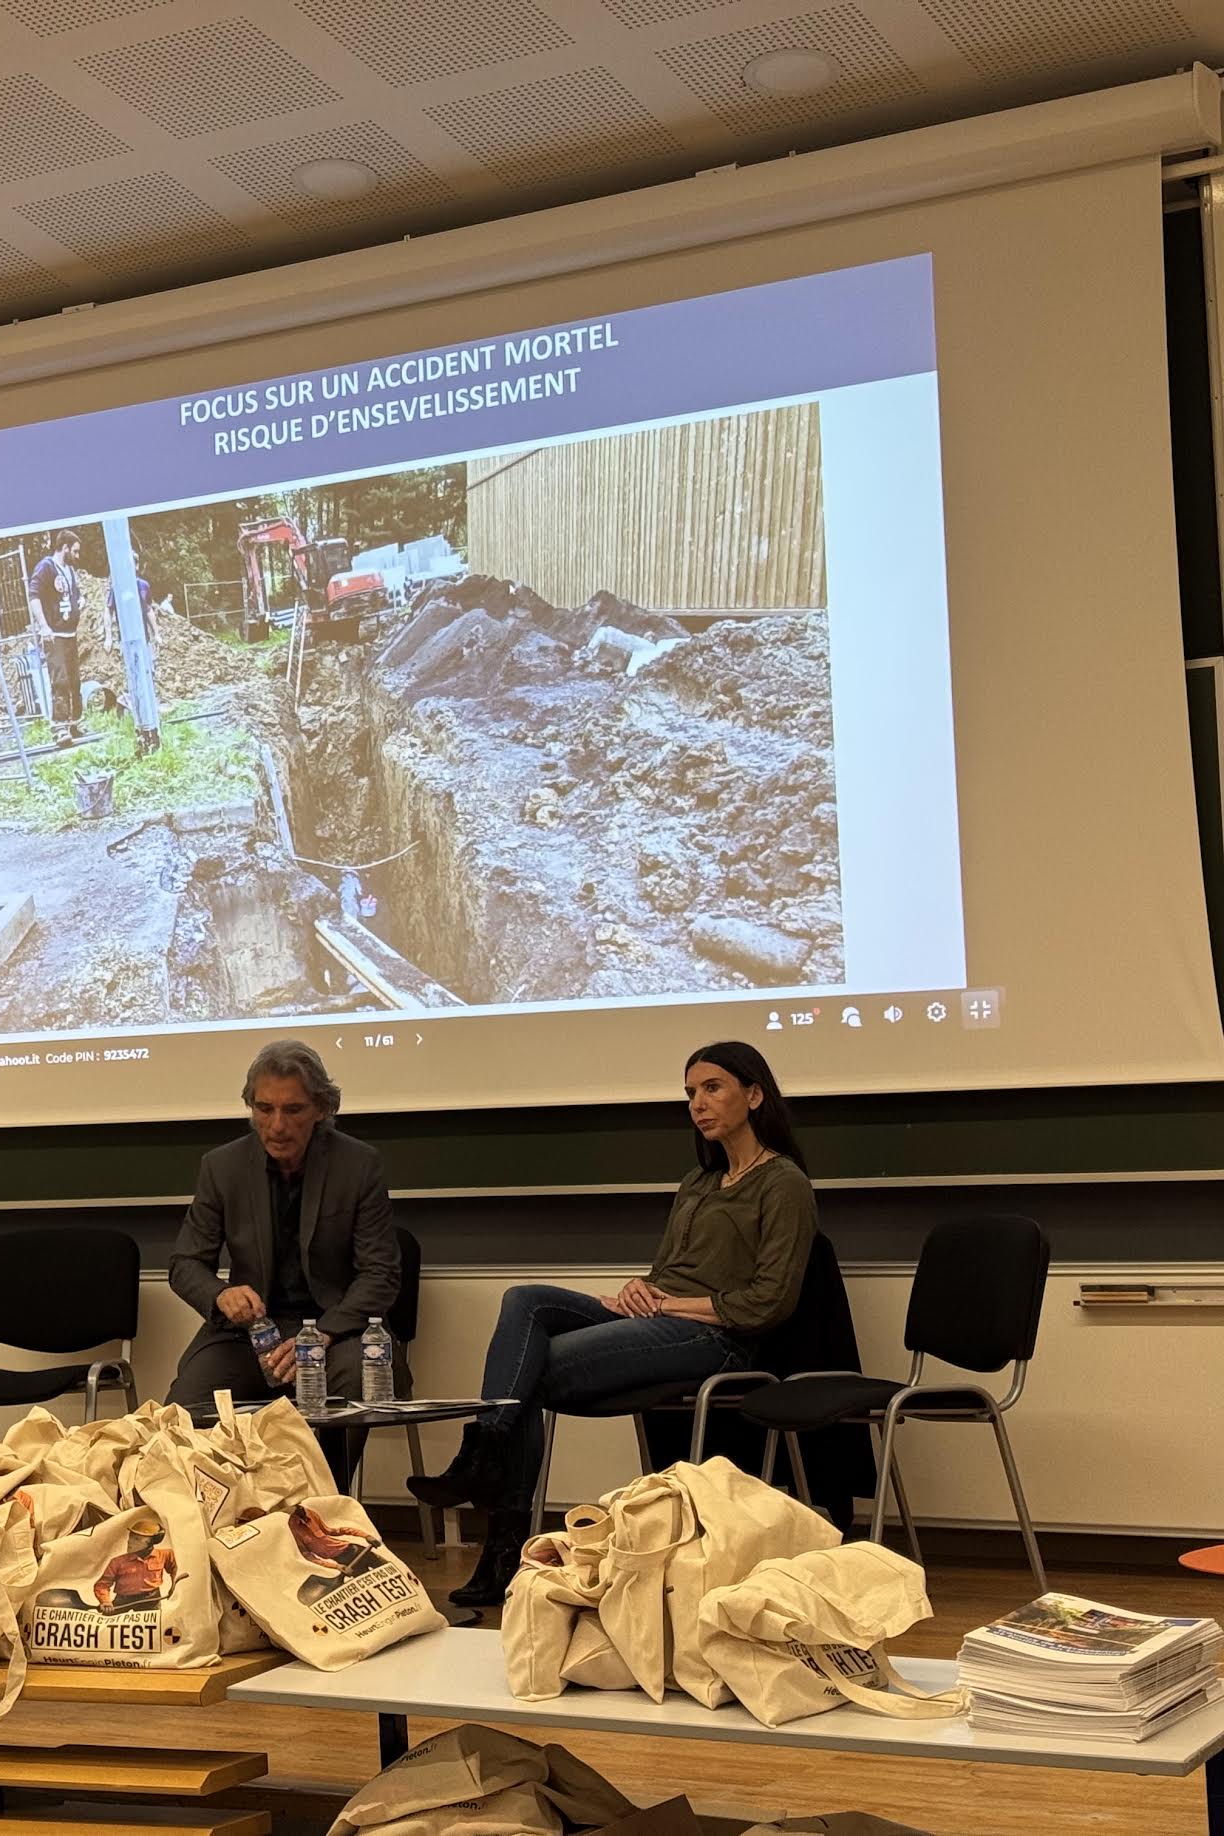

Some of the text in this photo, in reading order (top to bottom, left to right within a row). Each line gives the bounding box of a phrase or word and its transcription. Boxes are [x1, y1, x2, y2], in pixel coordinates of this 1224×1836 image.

[179, 322, 619, 427] FOCUS SUR UN ACCIDENT MORTEL
[214, 367, 582, 456] RISQUE D’ENSEVELISSEMENT
[790, 1011, 815, 1026] 125
[45, 1052, 74, 1064] Code
[103, 1048, 150, 1061] 9235472
[314, 1600, 327, 1615] LE
[323, 1582, 361, 1610] CHANTIER
[355, 1574, 375, 1590] C'EST
[373, 1568, 389, 1582] PAS
[325, 1574, 413, 1630] CRASH TEST
[36, 1608, 47, 1620] LE
[49, 1609, 95, 1622] CHANTIER
[123, 1612, 141, 1623] PAS
[143, 1612, 158, 1624] UN
[35, 1621, 158, 1650] CRASH TEST
